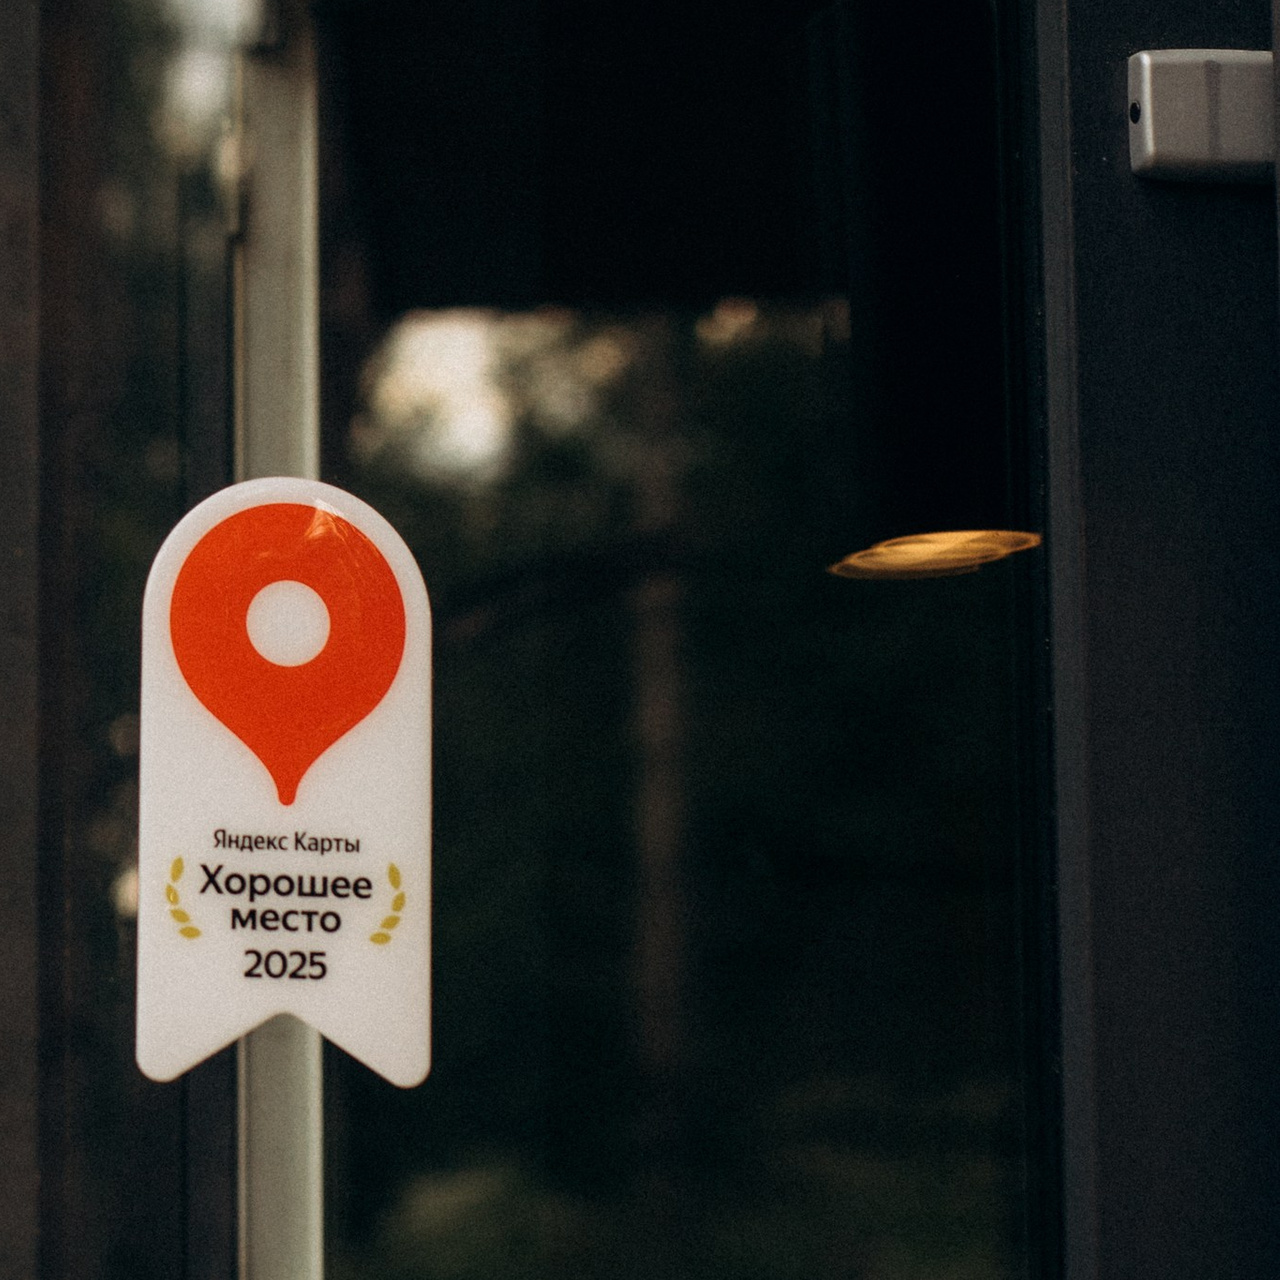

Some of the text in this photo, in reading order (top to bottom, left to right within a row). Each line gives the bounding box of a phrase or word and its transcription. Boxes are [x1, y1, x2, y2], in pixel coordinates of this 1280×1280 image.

[213, 829, 360, 856] Яндекс Карты
[200, 864, 373, 902] Хорошее
[230, 908, 342, 933] место
[243, 949, 327, 980] 2025
